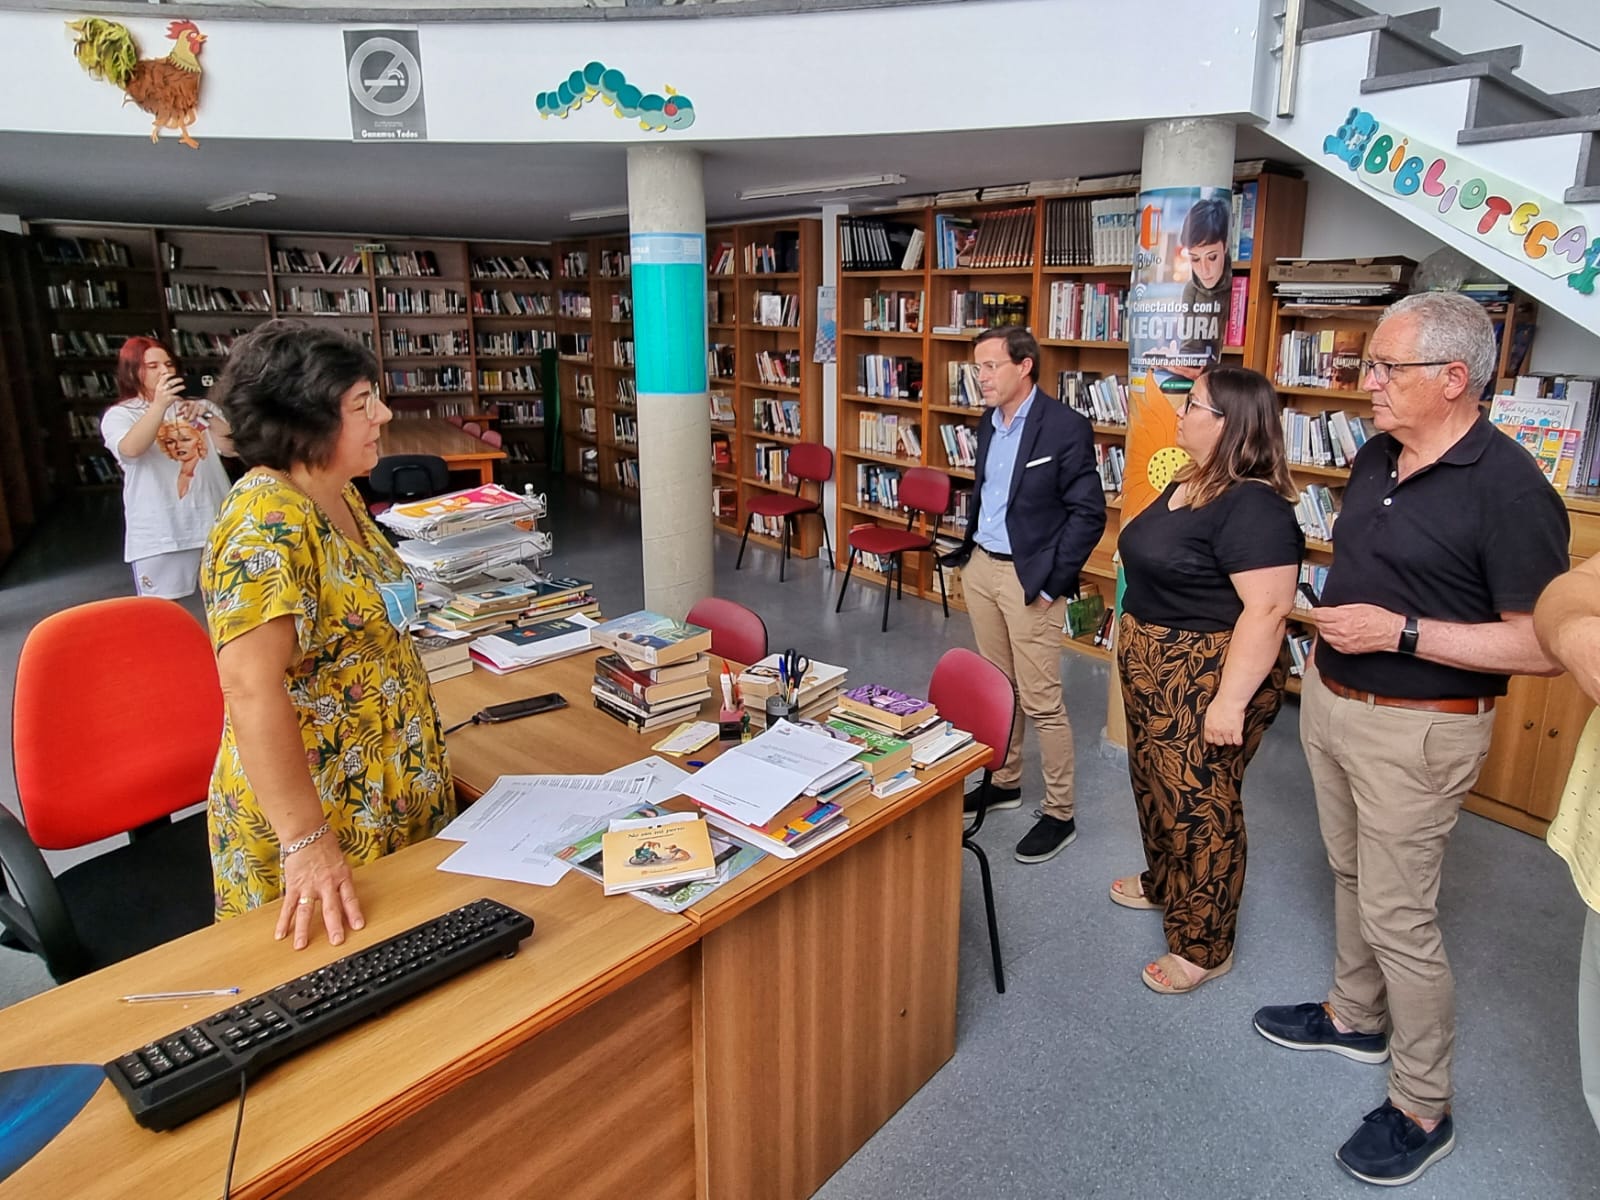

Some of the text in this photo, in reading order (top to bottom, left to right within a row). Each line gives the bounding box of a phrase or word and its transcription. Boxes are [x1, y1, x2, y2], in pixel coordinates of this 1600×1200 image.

[396, 129, 418, 138] Todos
[1133, 301, 1189, 313] Conectados
[1192, 302, 1212, 313] con
[1131, 315, 1219, 340] LECTURA
